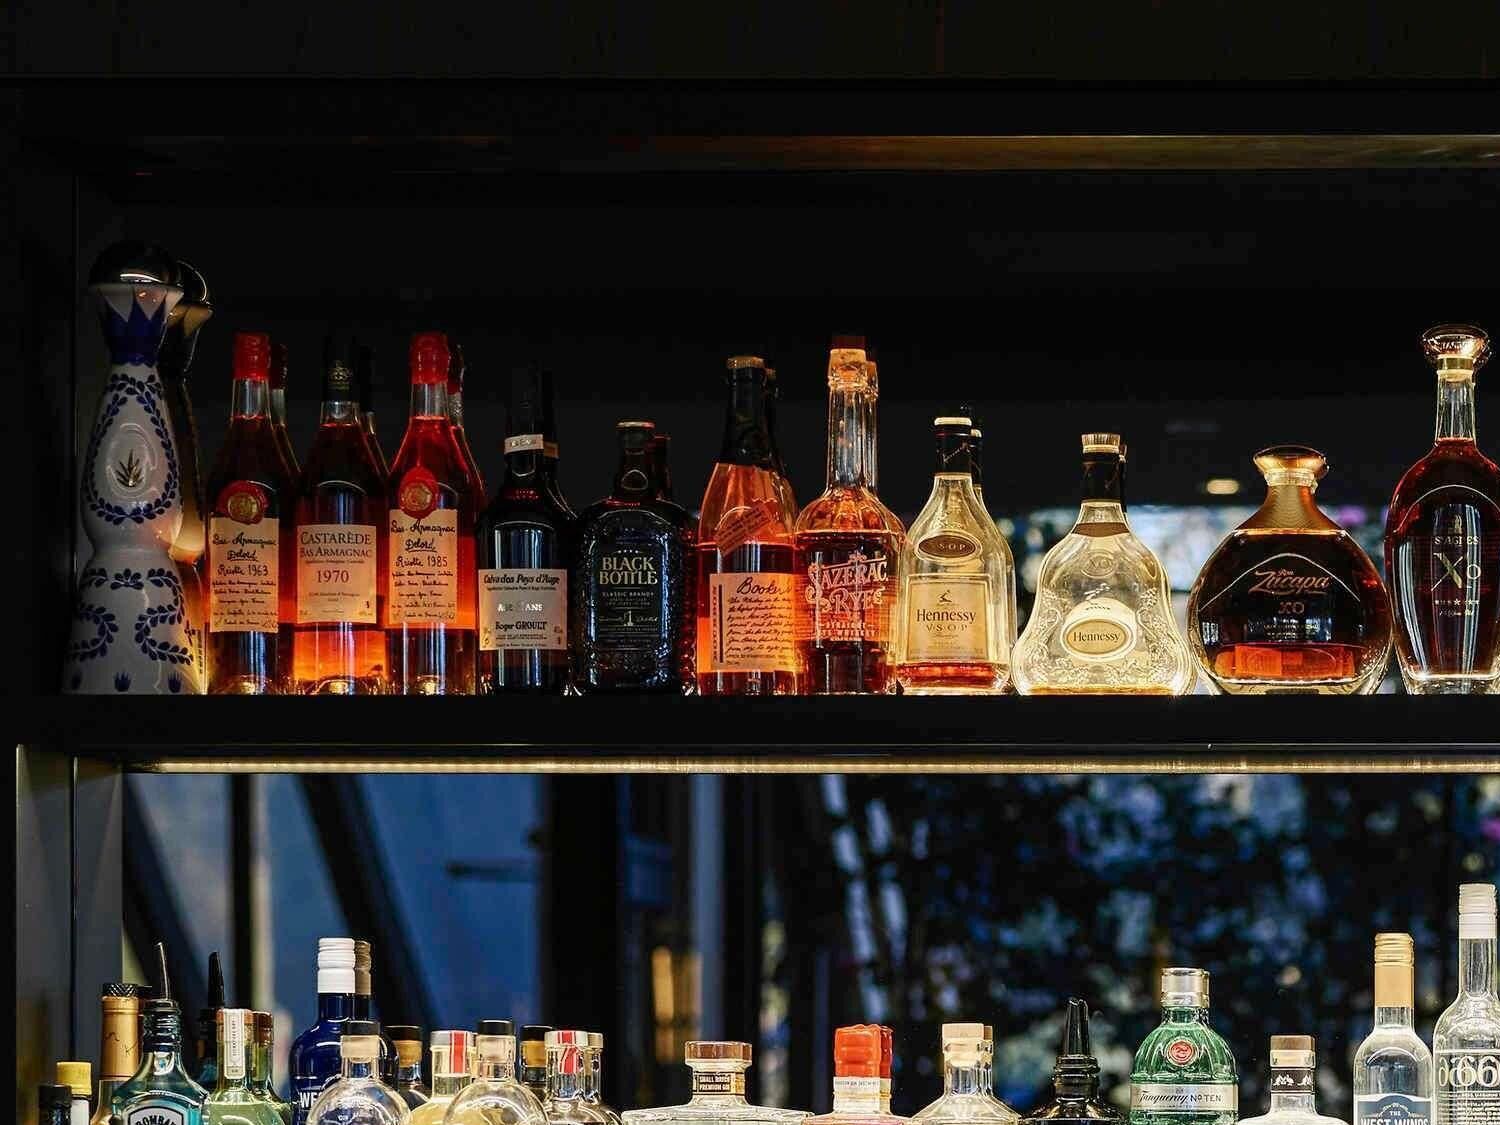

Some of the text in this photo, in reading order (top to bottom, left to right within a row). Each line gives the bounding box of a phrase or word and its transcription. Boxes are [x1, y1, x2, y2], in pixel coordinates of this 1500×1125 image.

[426, 556, 448, 568] 1985
[602, 556, 654, 571] BLACK
[316, 569, 350, 585] 1970
[599, 569, 659, 586] BOTTLE
[807, 561, 889, 591] SAZERAC
[1248, 569, 1331, 596] Zacapa
[916, 608, 977, 624] Hennessy
[1072, 630, 1121, 644] Hennessy
[1137, 1091, 1222, 1107] Tanqueray TEN
